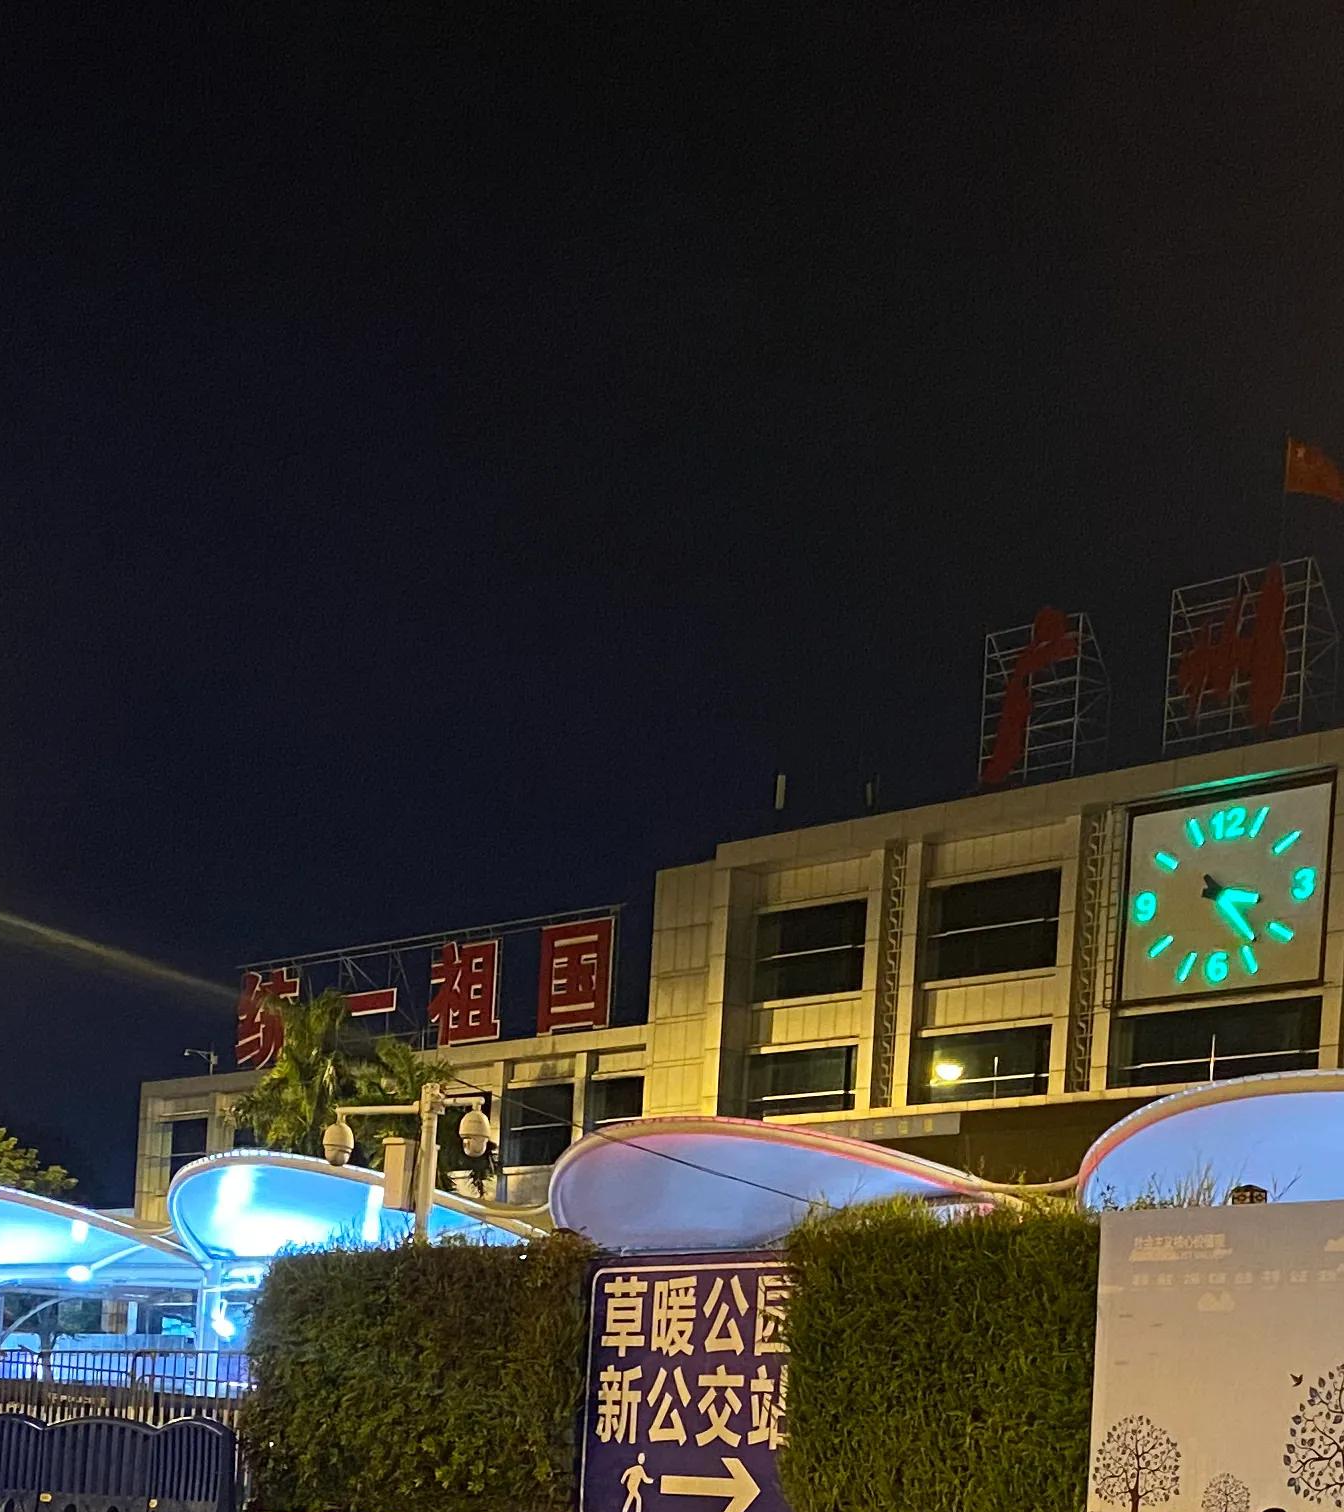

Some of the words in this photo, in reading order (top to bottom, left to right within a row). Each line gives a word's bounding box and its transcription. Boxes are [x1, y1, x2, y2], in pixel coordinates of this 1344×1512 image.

[1210, 806, 1248, 842] 12
[1291, 866, 1317, 901] 3
[1134, 891, 1158, 924] 9
[1204, 951, 1229, 983] 6
[601, 1274, 792, 1358] 草暖公园
[595, 1364, 790, 1451] 新公交站
